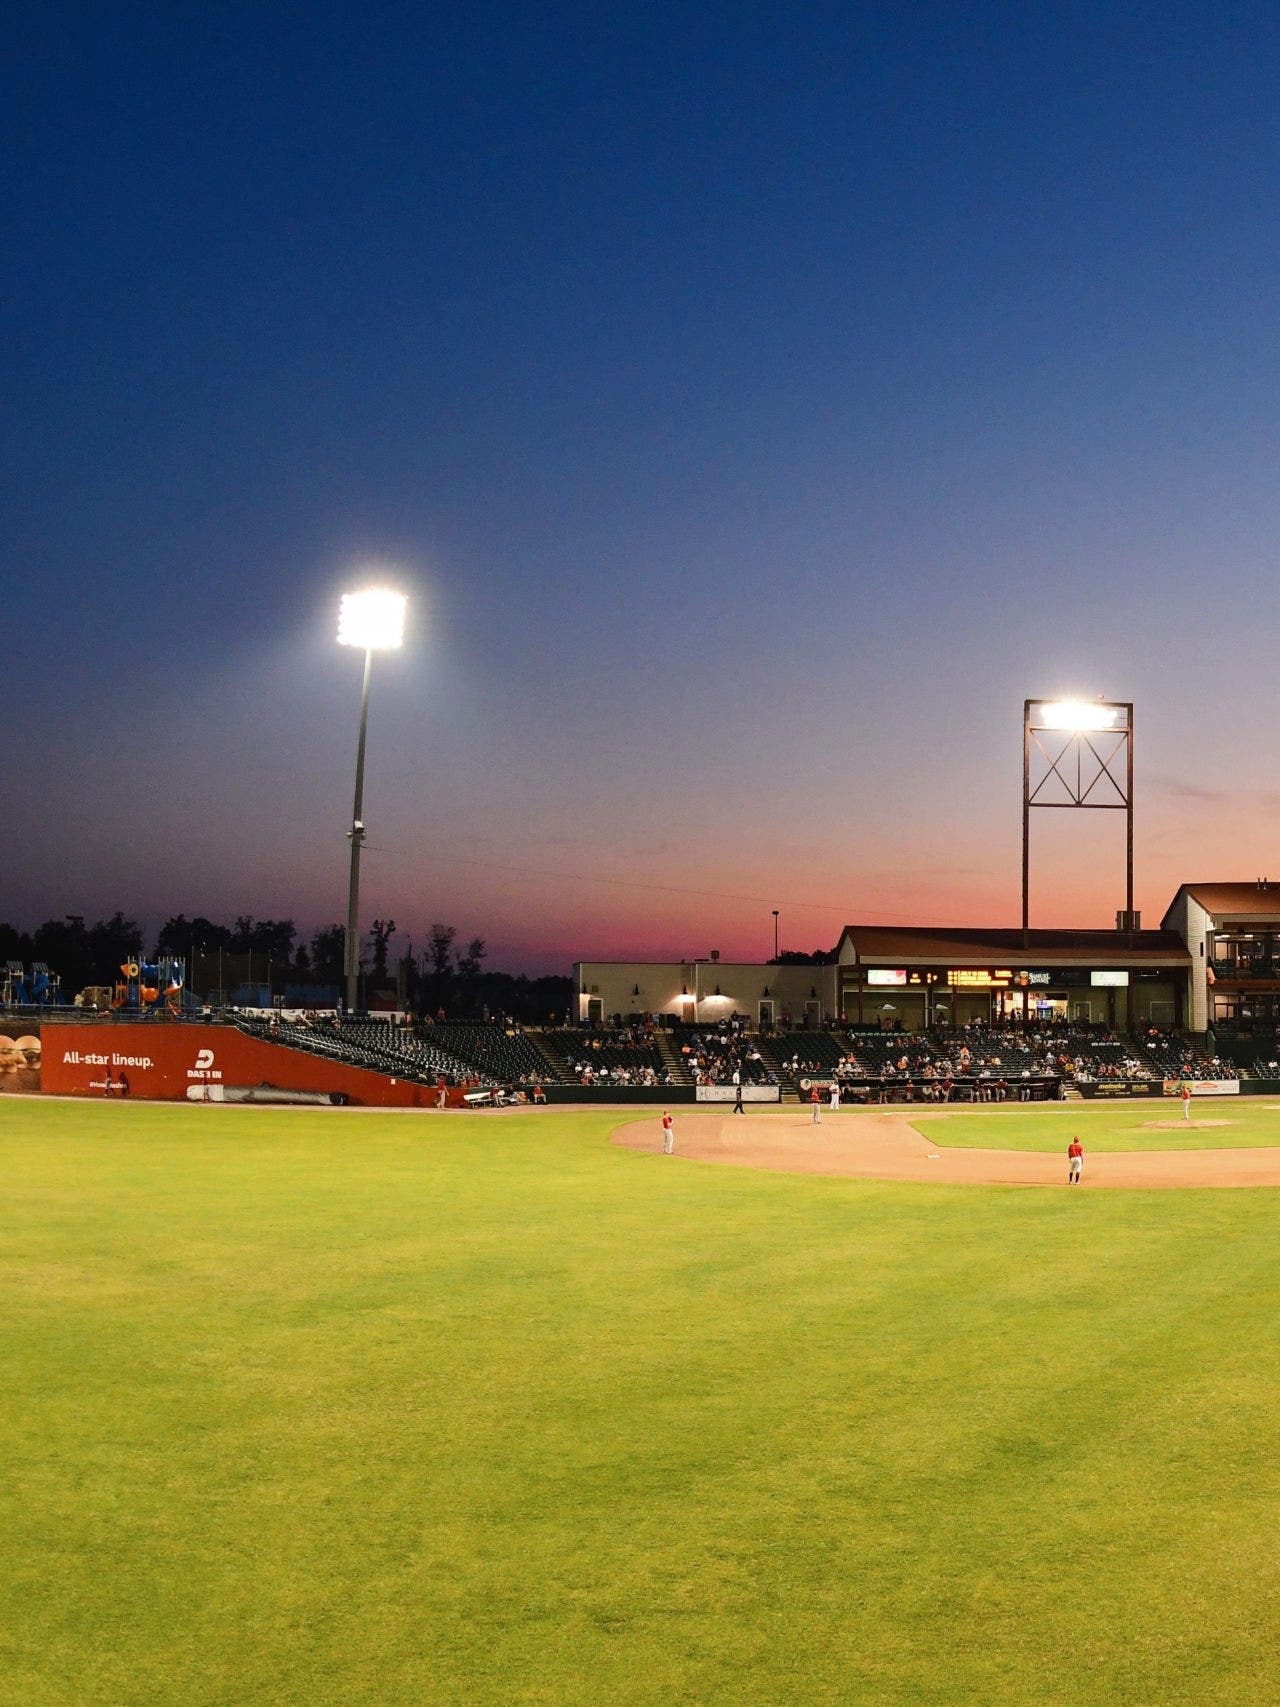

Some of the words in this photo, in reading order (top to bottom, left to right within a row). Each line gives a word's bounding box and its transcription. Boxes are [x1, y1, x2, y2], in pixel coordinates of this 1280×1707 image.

[63, 1051, 109, 1065] All-star
[112, 1053, 154, 1070] lineup.
[211, 1070, 222, 1079] IN
